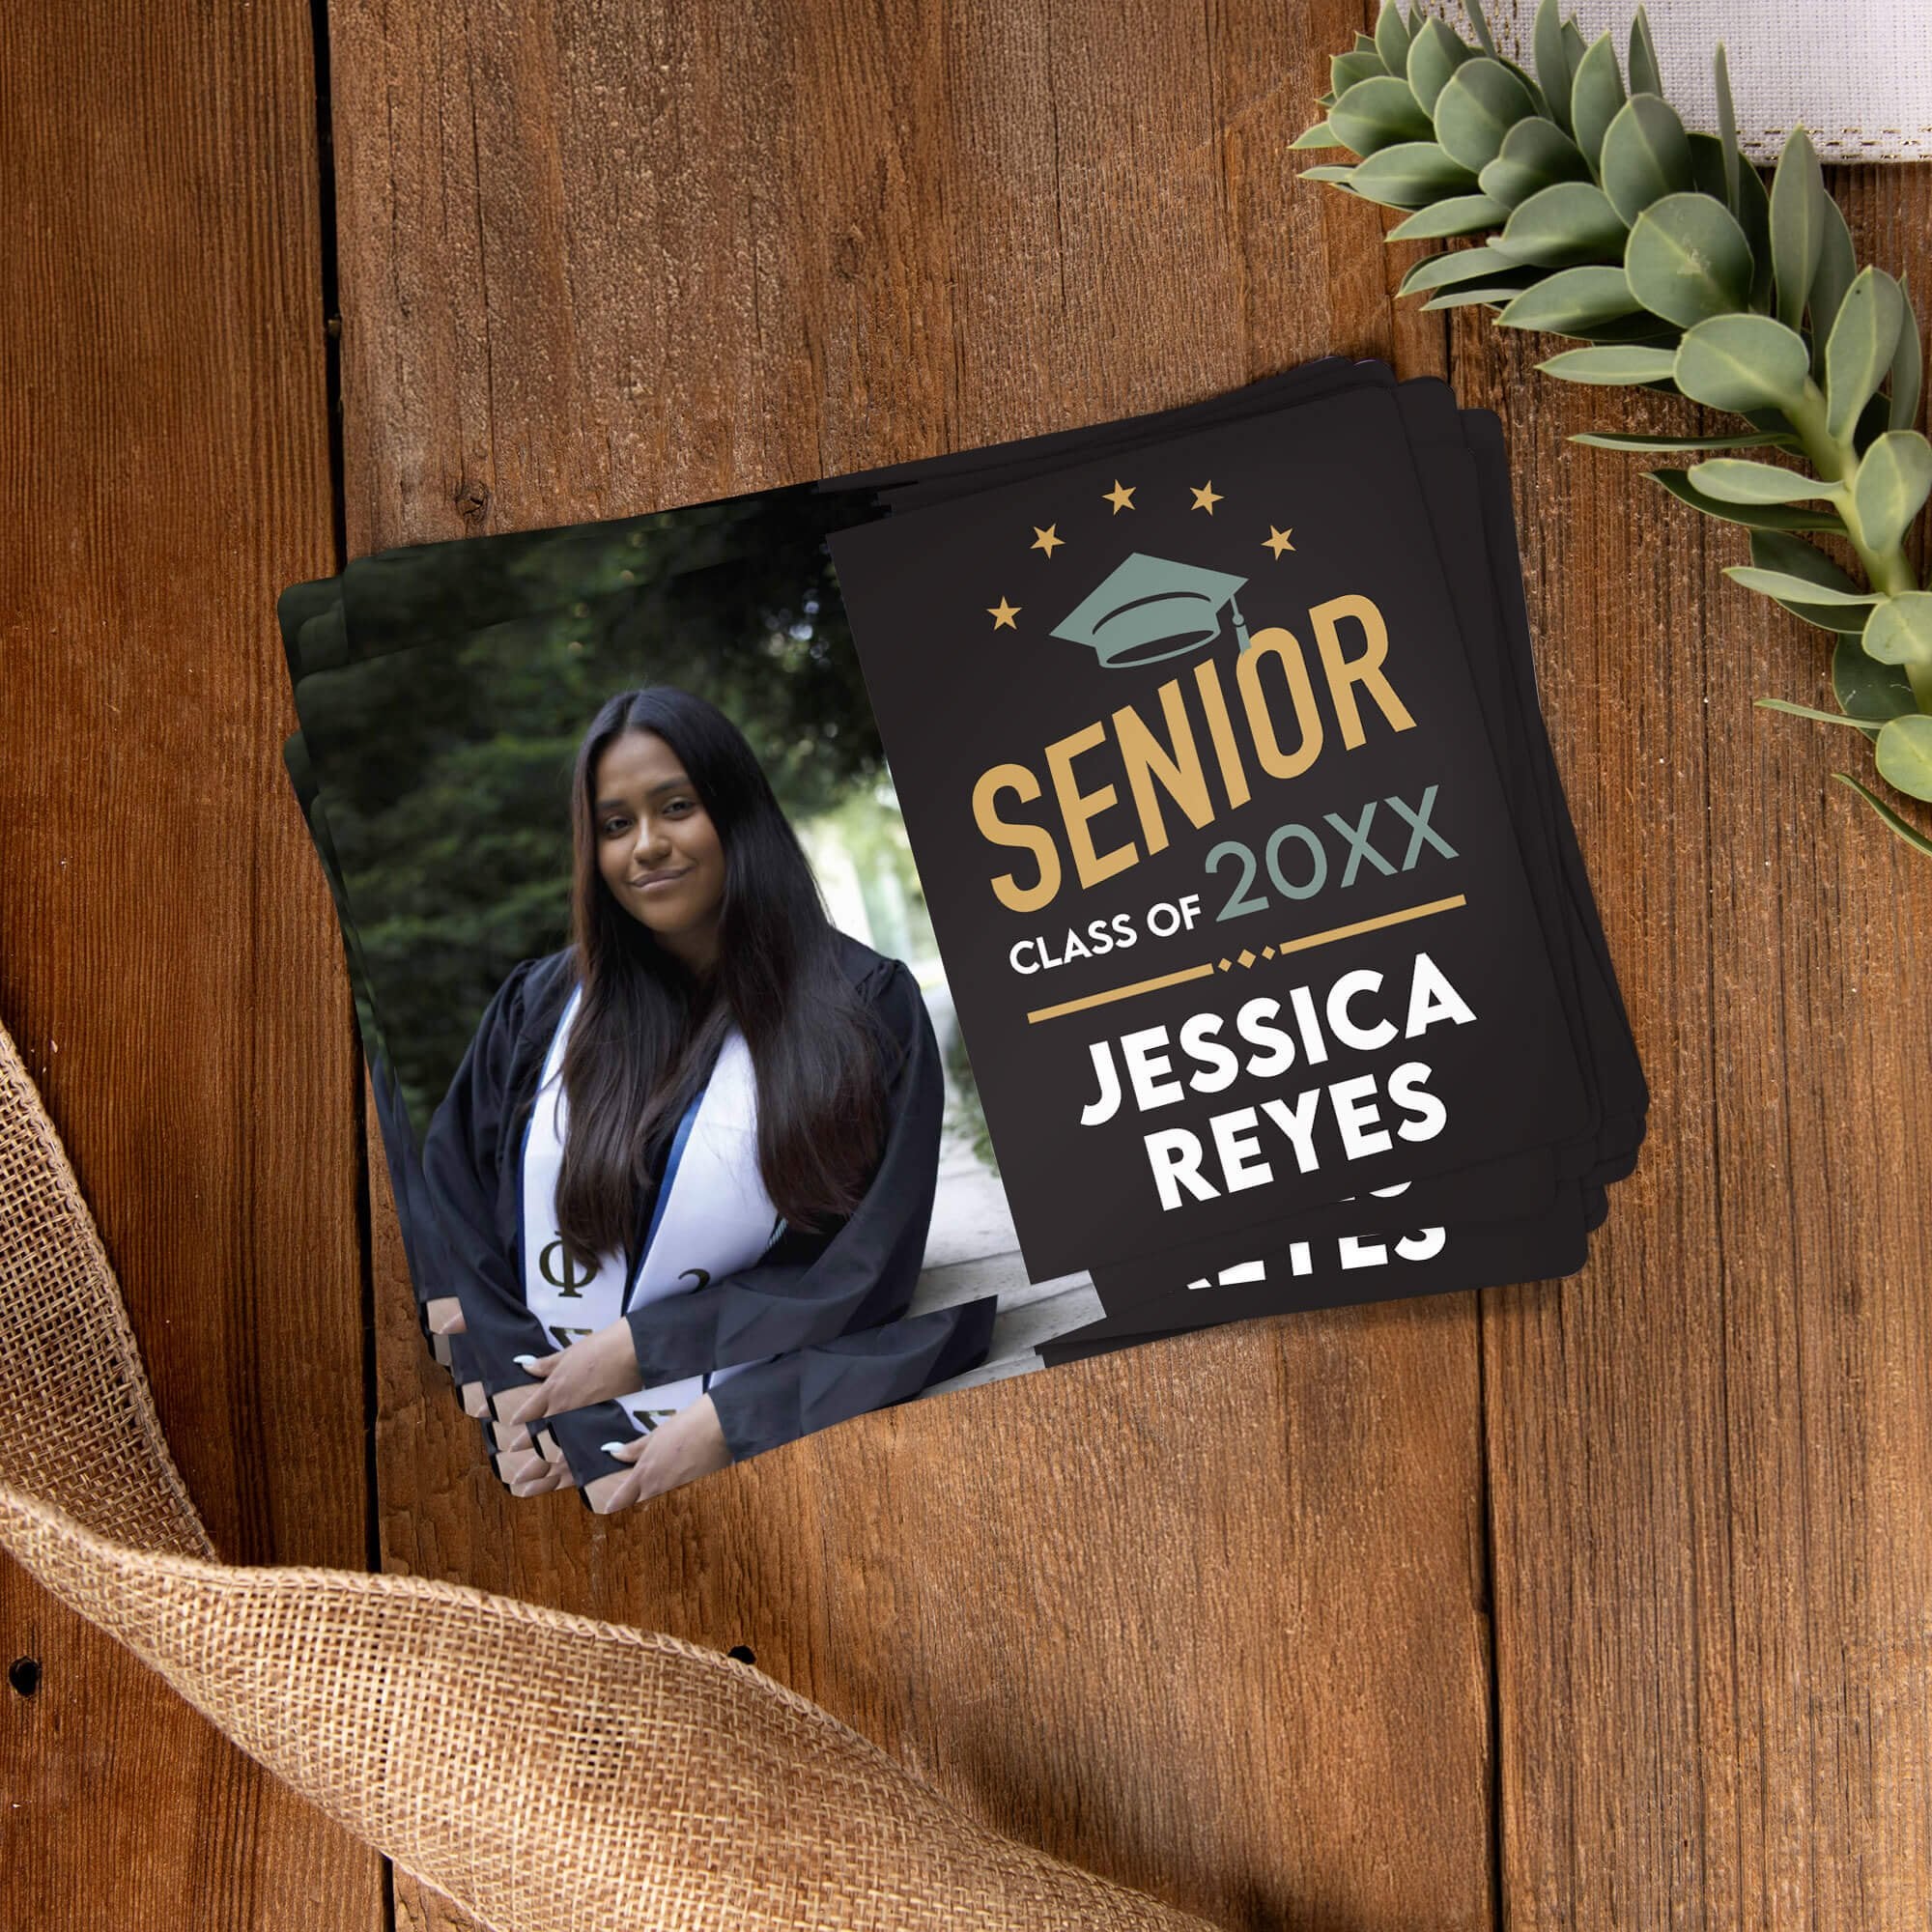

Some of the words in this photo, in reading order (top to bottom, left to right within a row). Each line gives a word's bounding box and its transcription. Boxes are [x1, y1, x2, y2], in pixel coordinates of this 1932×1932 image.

[972, 594, 1417, 913] SENIOR
[1009, 913, 1138, 976] CLASS
[1147, 894, 1202, 937] OF
[1205, 784, 1460, 922] 20XX
[1080, 952, 1477, 1126] JESSICA
[1143, 1062, 1447, 1211] REYES
